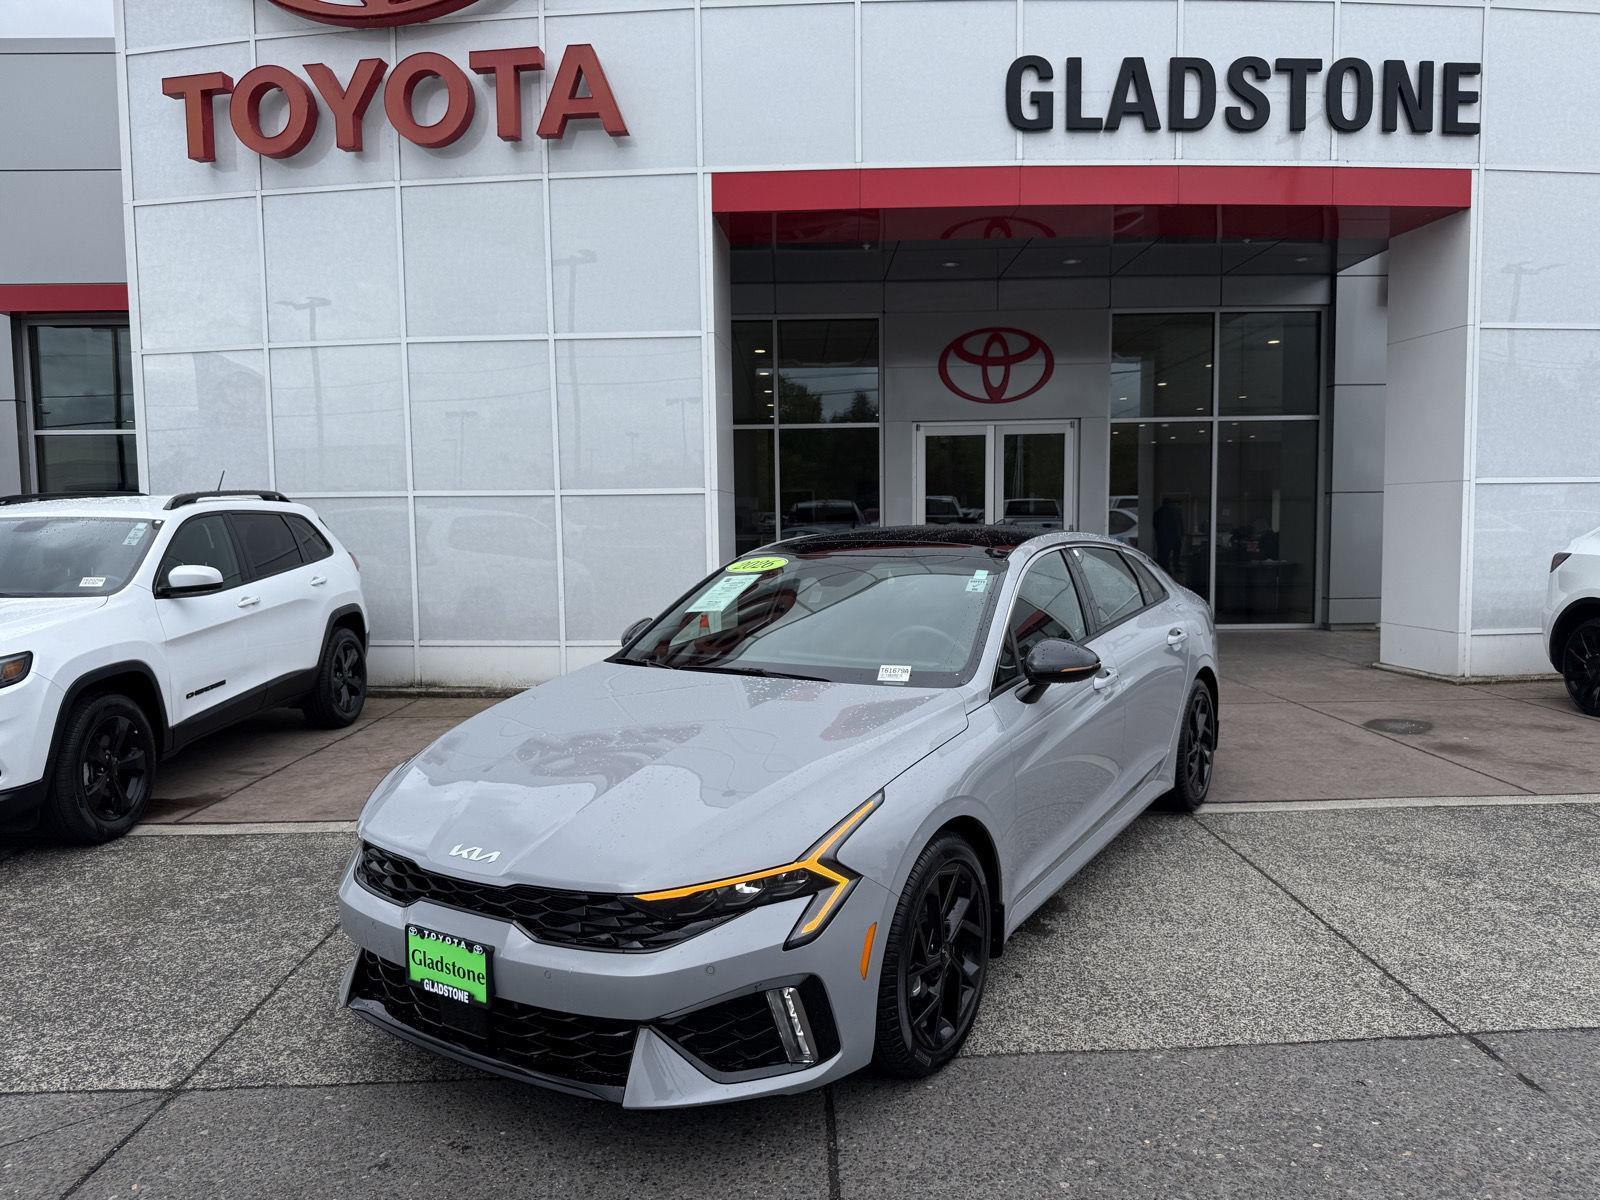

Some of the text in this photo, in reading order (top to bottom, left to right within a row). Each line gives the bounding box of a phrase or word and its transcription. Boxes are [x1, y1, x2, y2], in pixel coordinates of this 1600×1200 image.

[162, 44, 630, 164] TOYOTA
[1005, 55, 1481, 136] GLADSTONE
[449, 843, 501, 864] KIA
[423, 930, 467, 949] TOYOTA
[411, 948, 486, 985] Gladstone
[423, 979, 469, 1003] GLADSTONE
